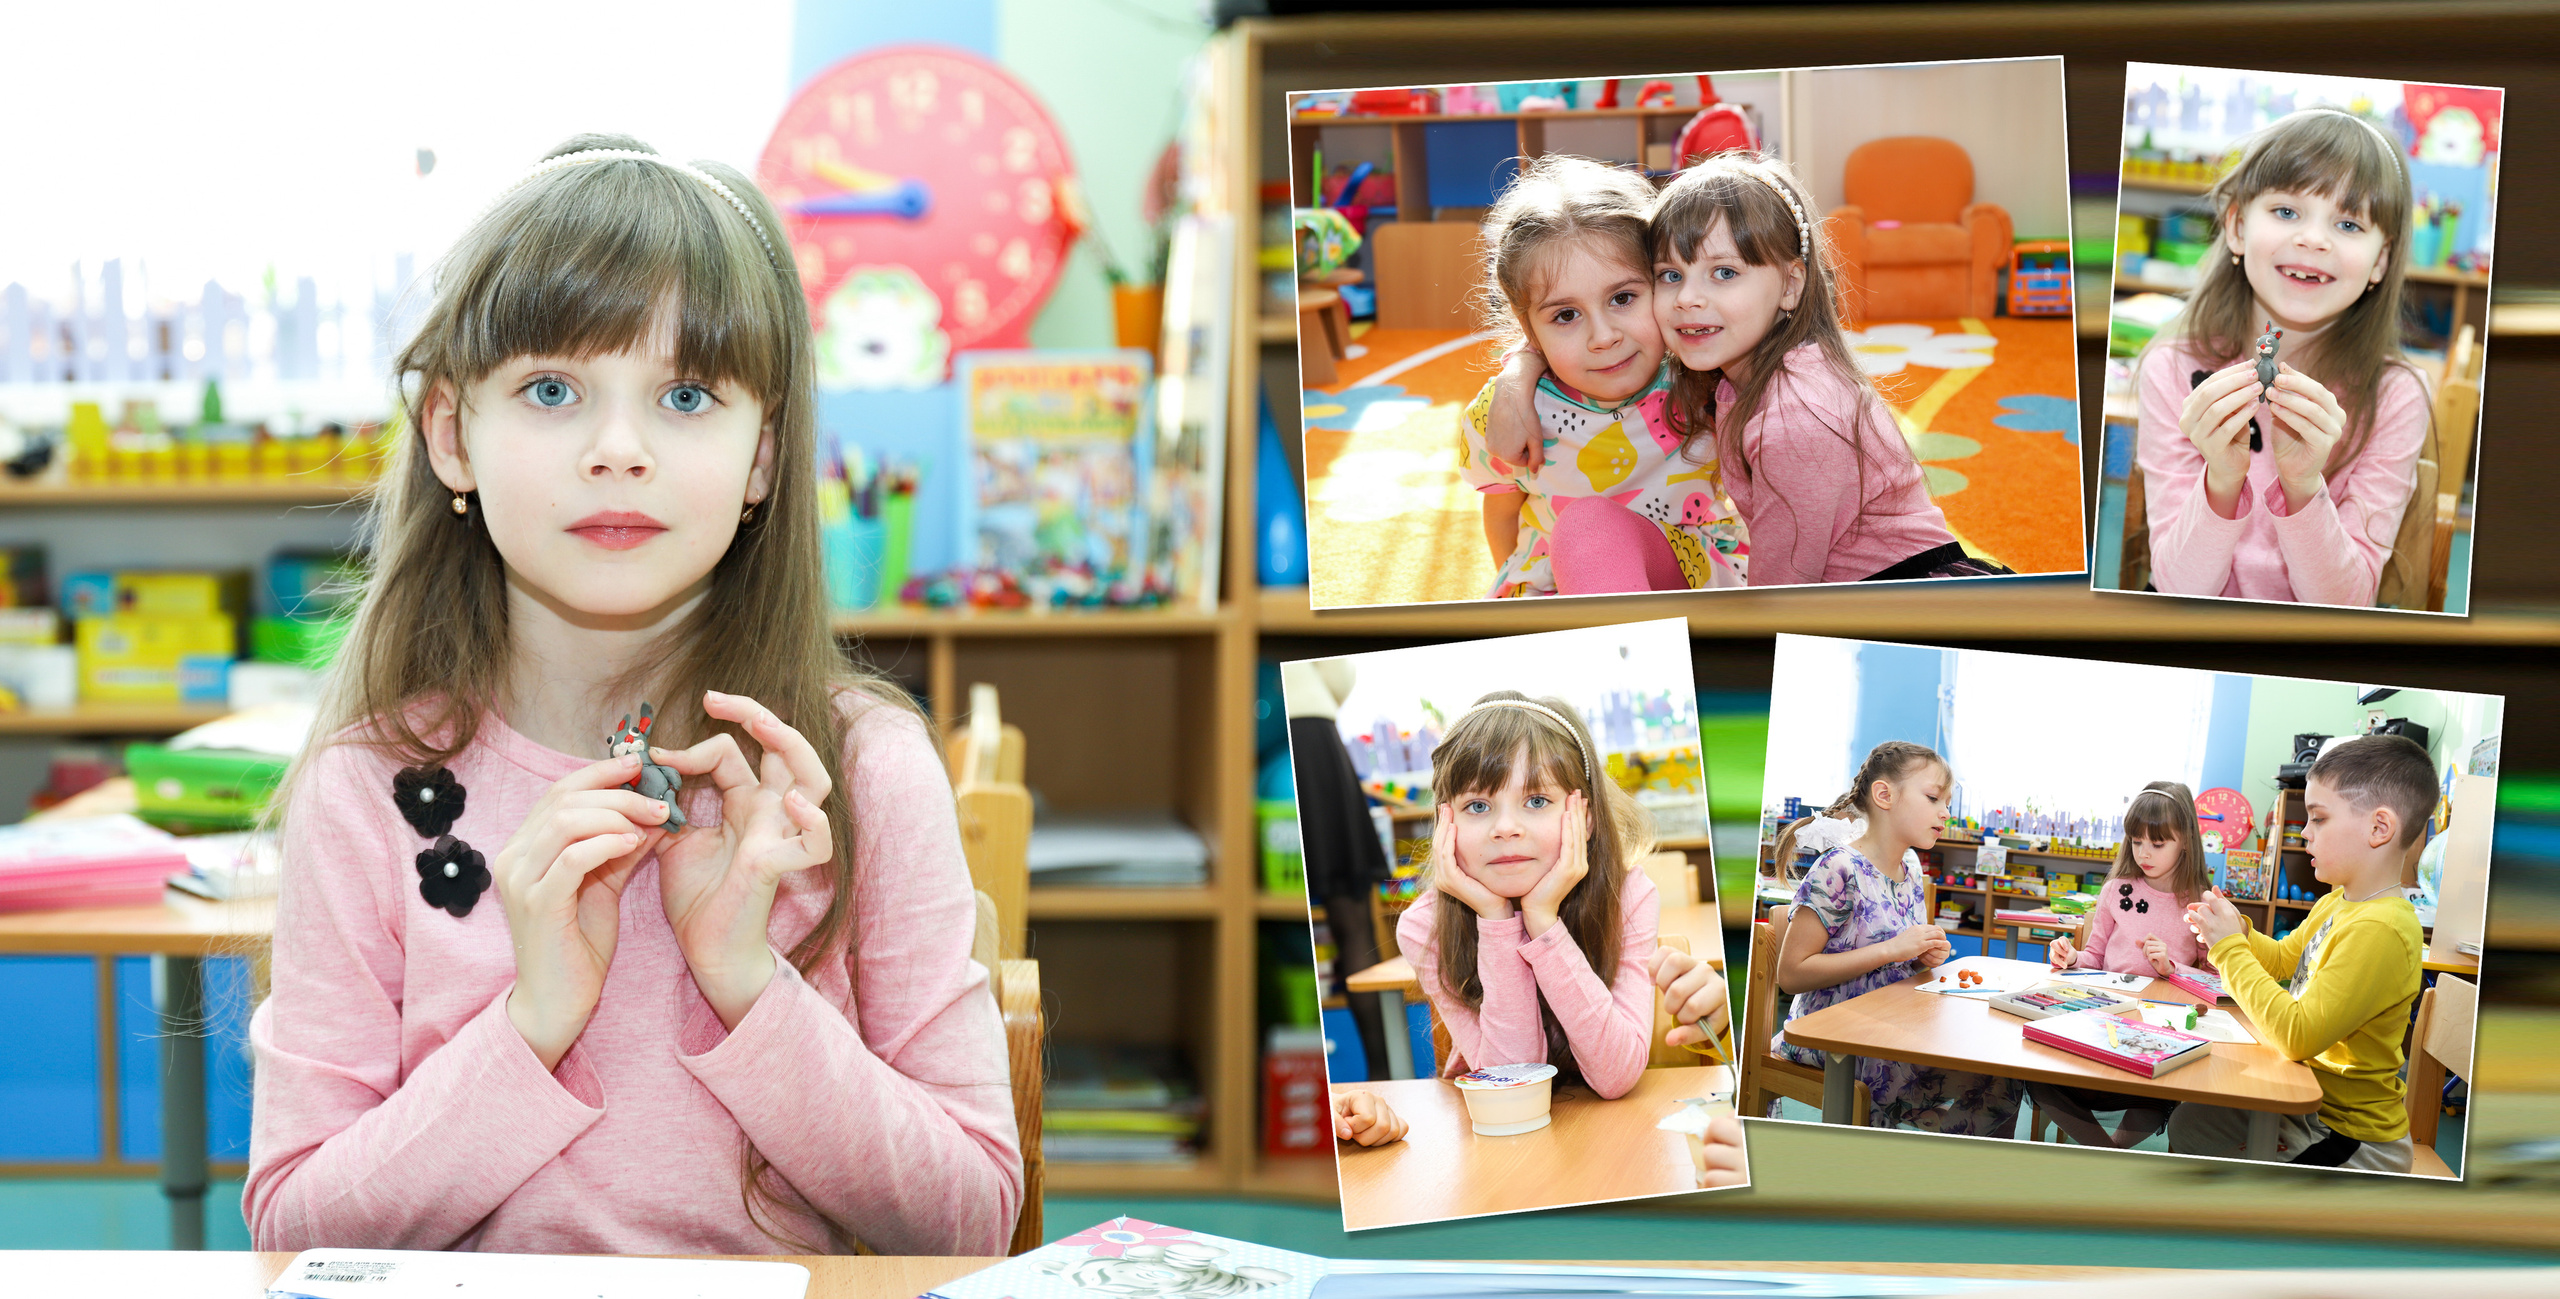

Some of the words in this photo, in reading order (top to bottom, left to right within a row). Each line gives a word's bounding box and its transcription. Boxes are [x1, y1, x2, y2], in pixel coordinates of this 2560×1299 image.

[2206, 795, 2216, 803] 11
[2218, 793, 2228, 801] 12
[2240, 806, 2246, 814] 2
[2242, 816, 2248, 824] 3
[2227, 834, 2233, 842] 5
